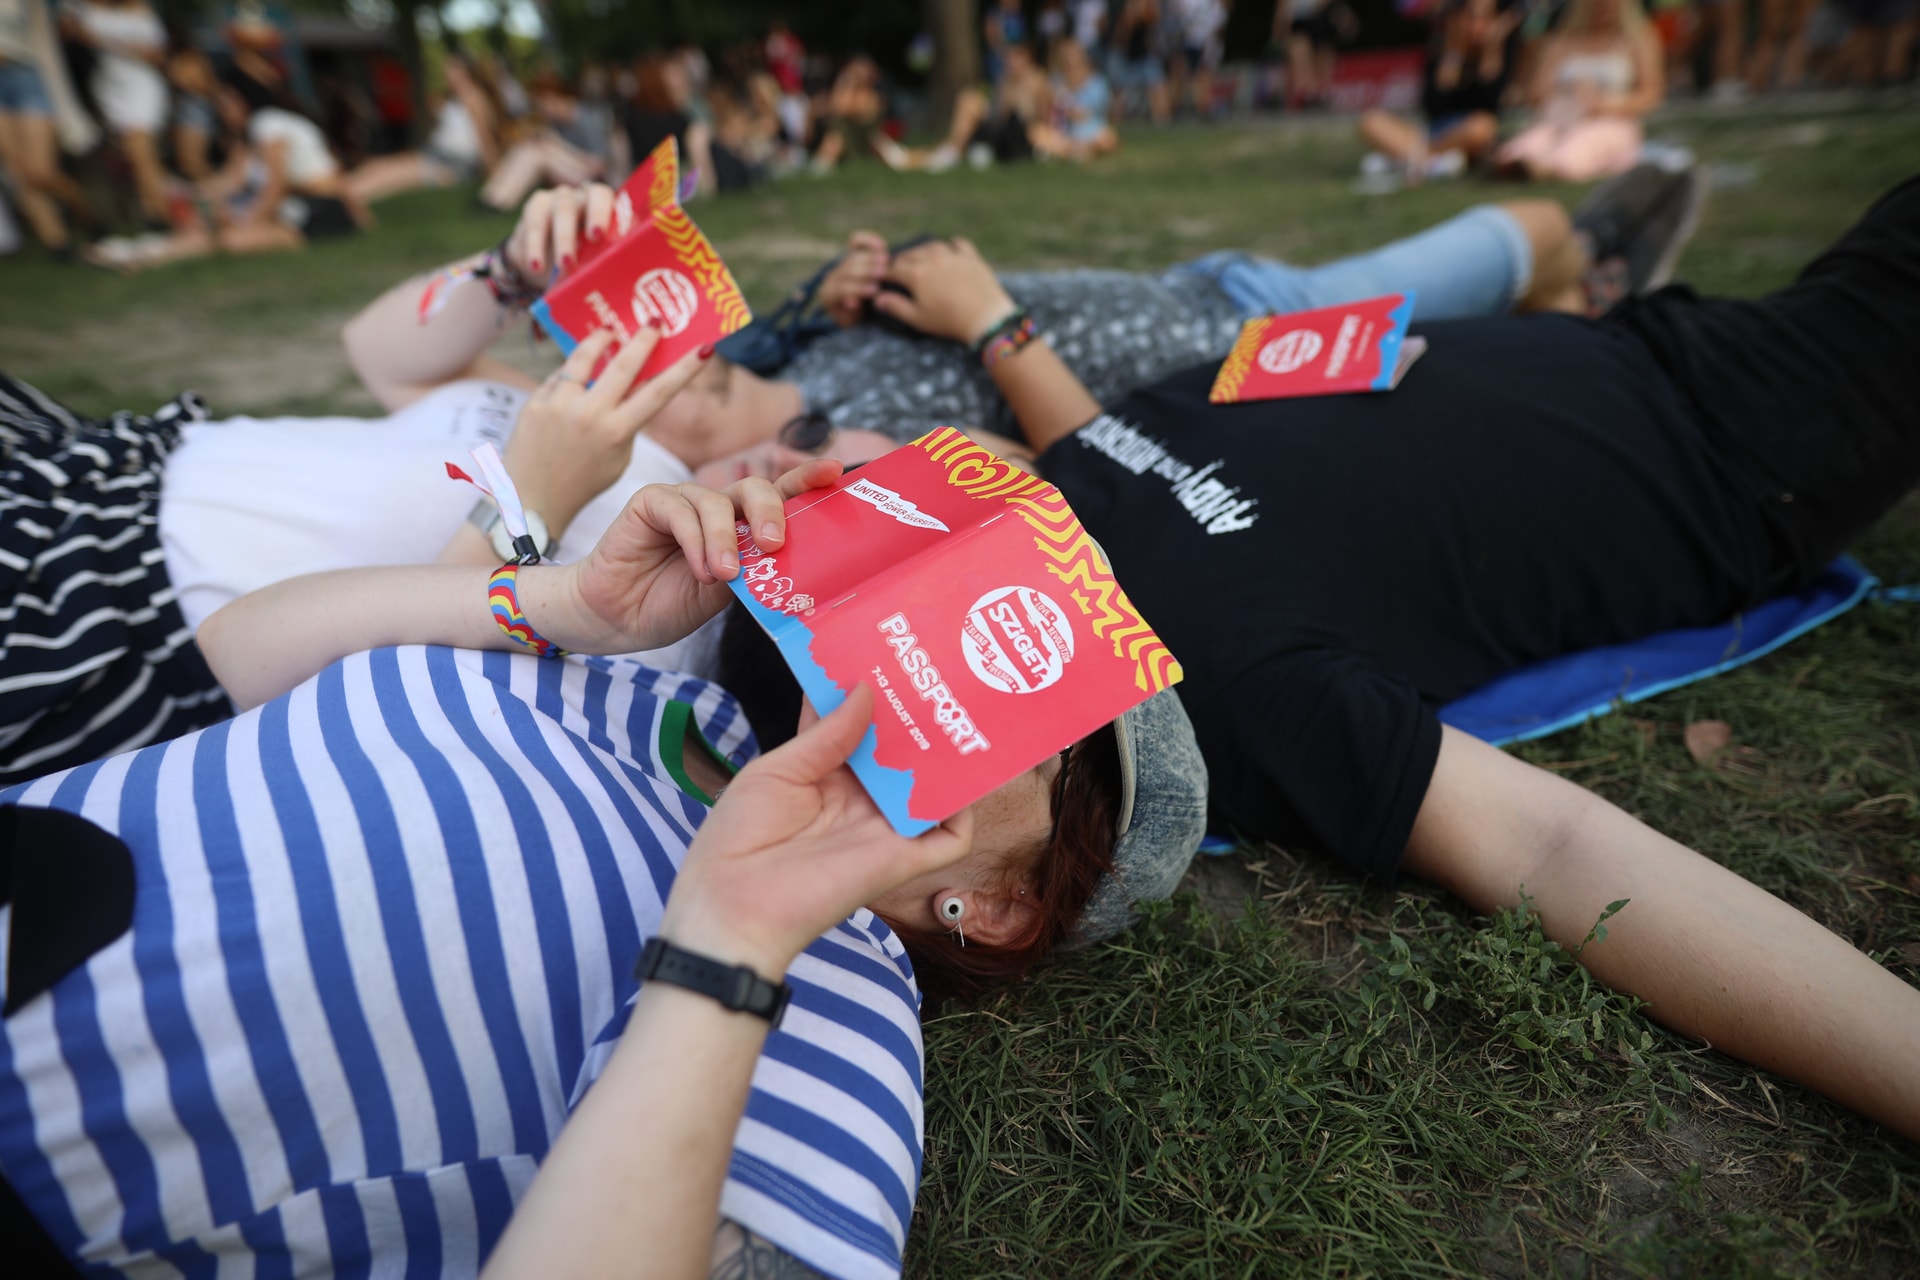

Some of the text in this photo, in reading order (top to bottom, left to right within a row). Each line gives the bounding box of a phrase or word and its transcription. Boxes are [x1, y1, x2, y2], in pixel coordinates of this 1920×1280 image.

[853, 483, 889, 502] UNITED
[881, 502, 908, 516] POWER
[965, 624, 1014, 686] ISLAND OF FREEDOM
[1035, 602, 1072, 664] LOVE REVOLUTION
[871, 665, 890, 689] 7-13
[883, 688, 916, 727] AUGUST
[878, 612, 991, 755] PASSPORT
